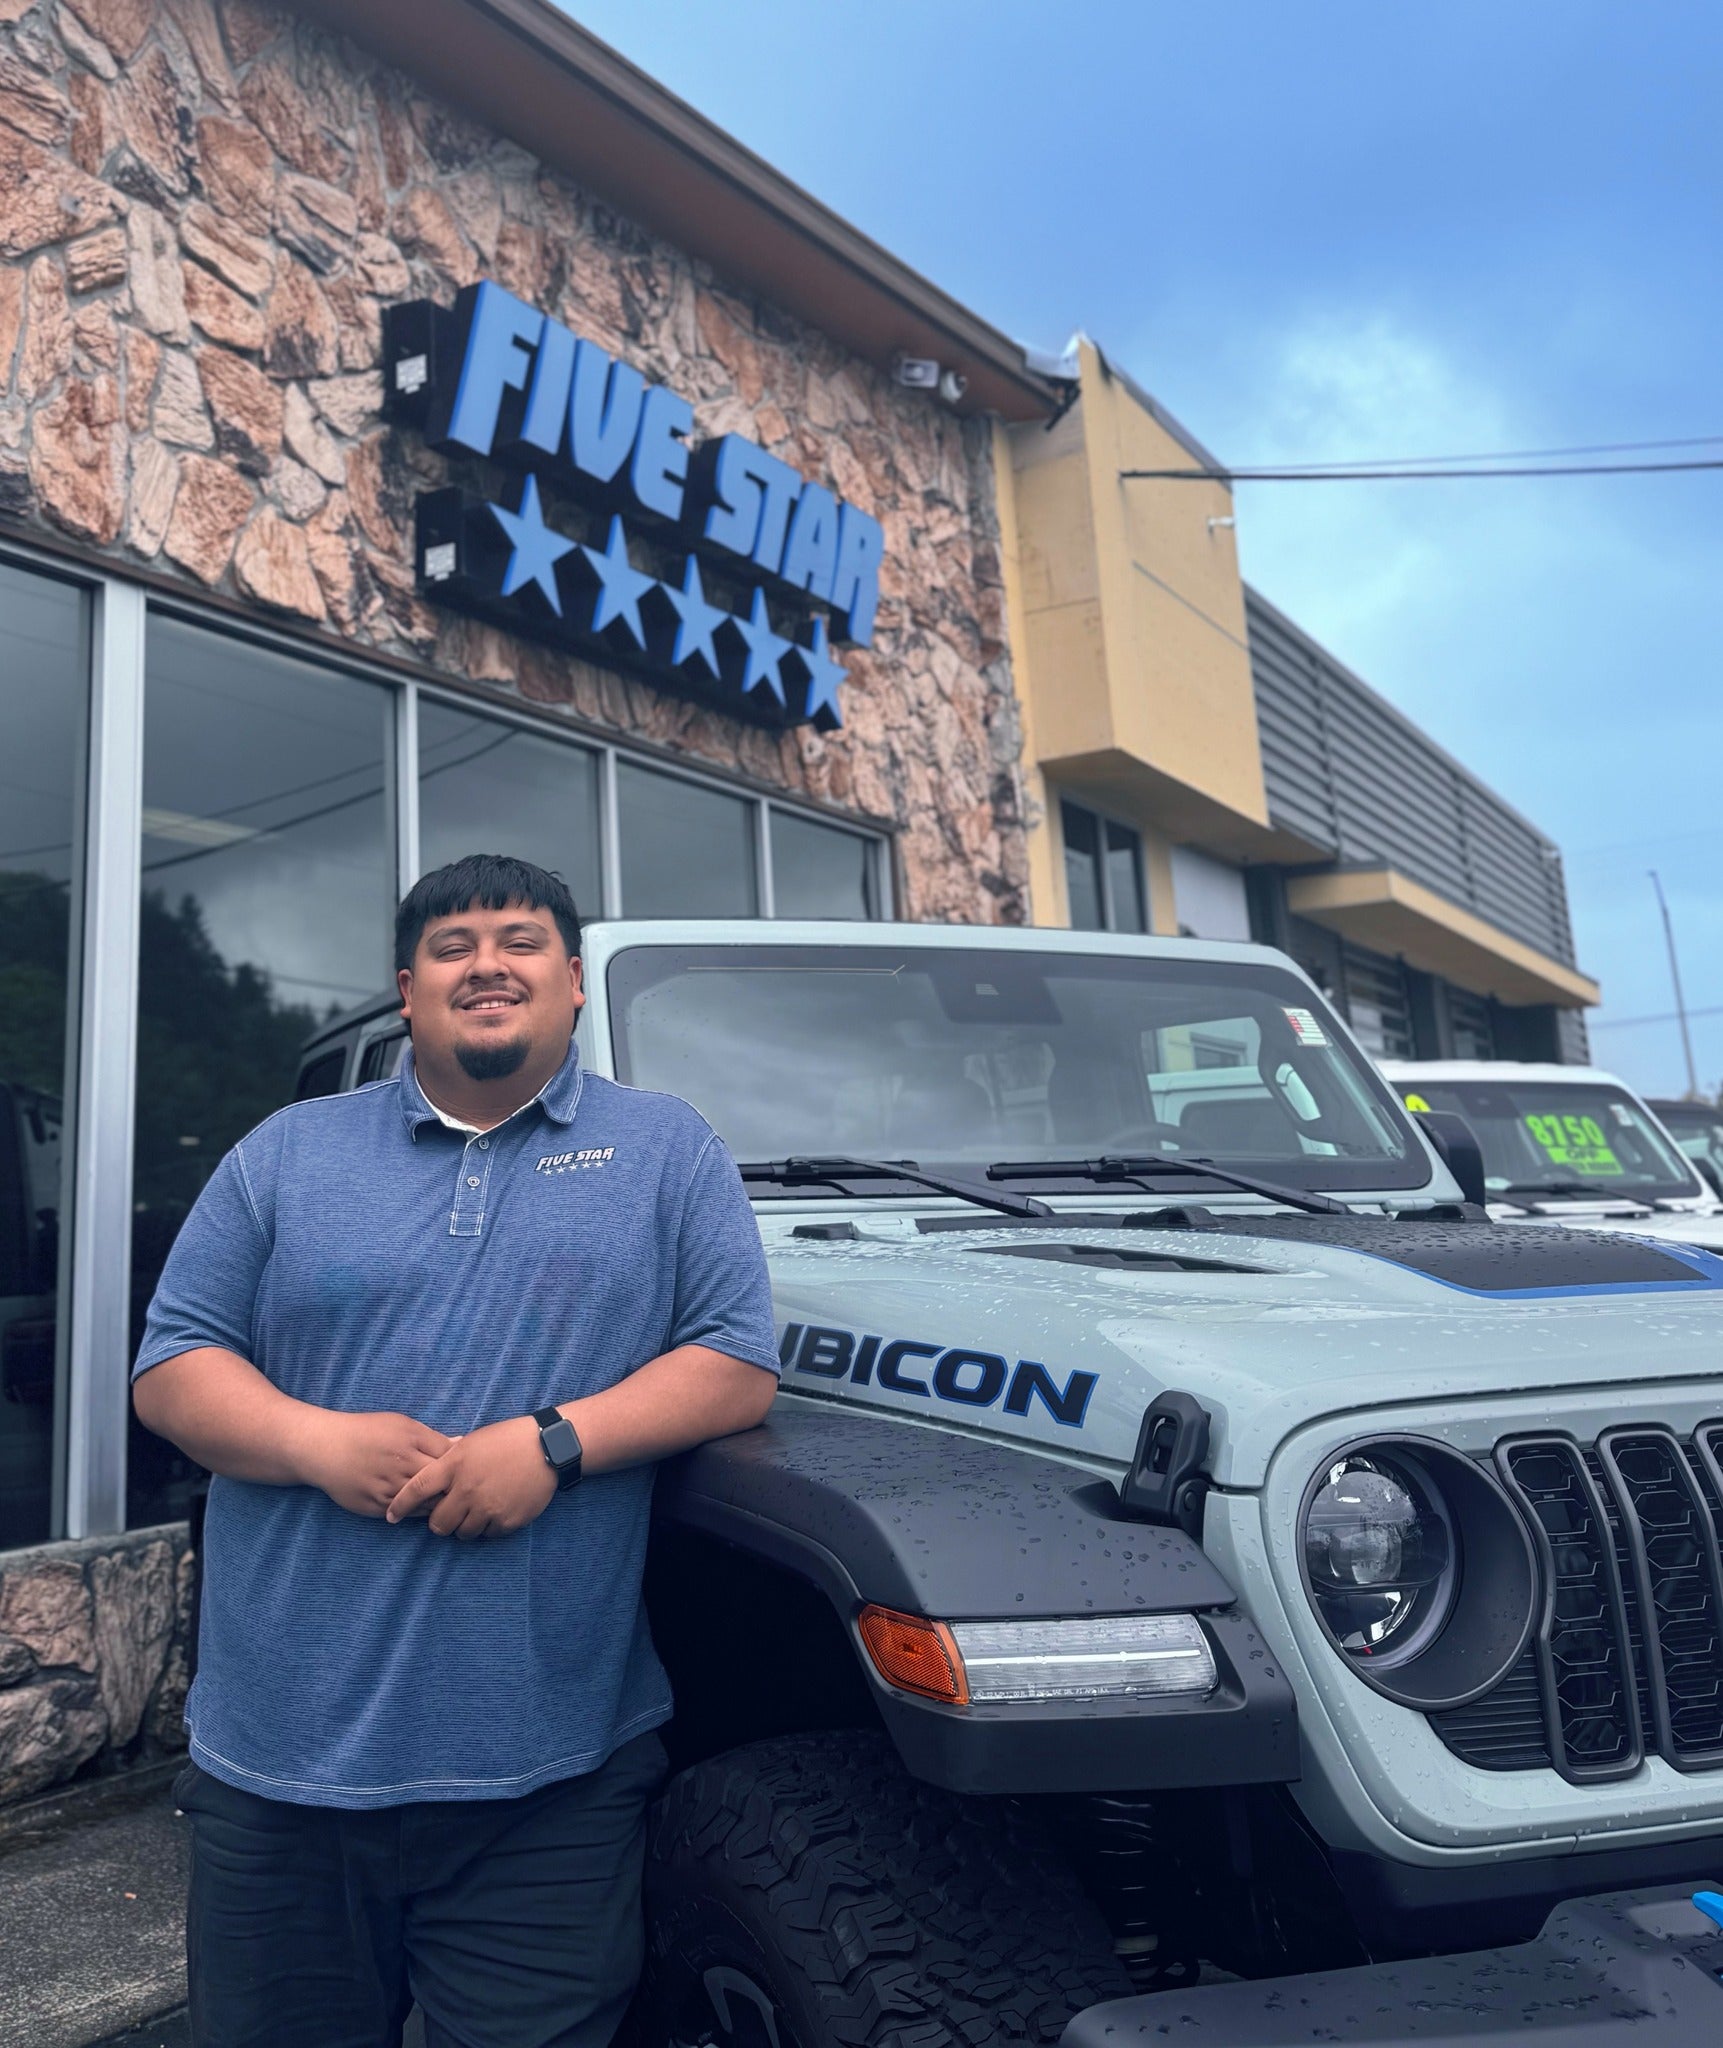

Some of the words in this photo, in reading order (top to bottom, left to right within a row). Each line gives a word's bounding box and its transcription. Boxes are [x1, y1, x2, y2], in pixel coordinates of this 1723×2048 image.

[447, 279, 693, 521] FIVE
[703, 431, 884, 648] STAR
[1525, 1114, 1607, 1146] 8750
[535, 1152, 575, 1171] FIVE
[575, 1147, 615, 1161] STAR
